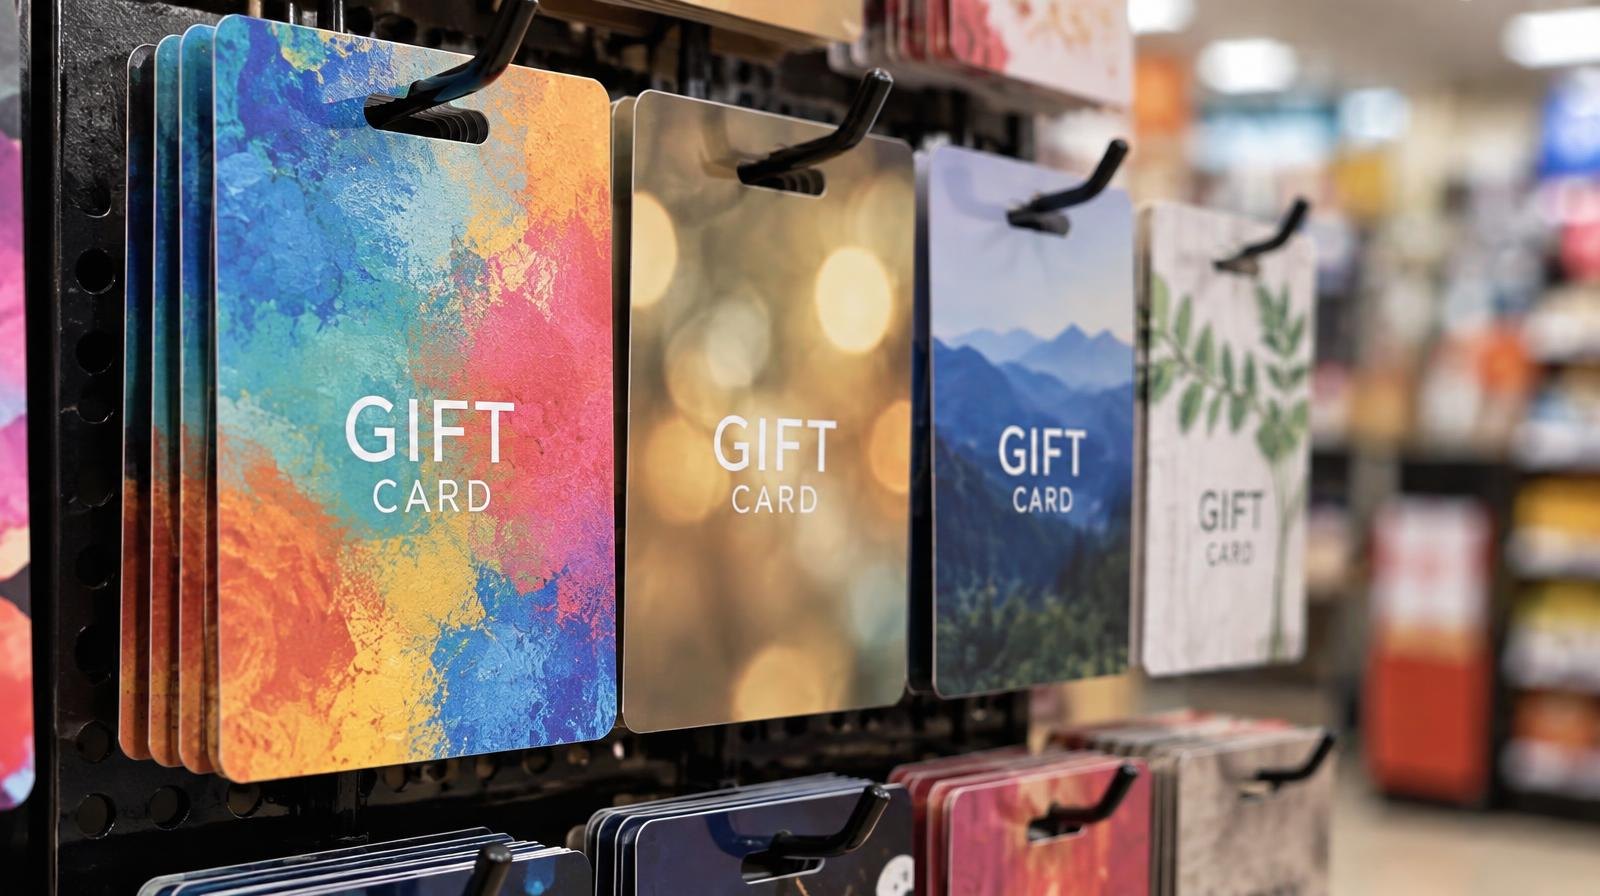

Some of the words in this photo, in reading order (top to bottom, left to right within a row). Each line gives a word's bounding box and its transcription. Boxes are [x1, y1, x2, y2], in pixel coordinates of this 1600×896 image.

[345, 395, 515, 463] GIFT
[713, 414, 838, 473] GIFT
[998, 425, 1087, 477] GIFT
[373, 478, 491, 513] CARD
[732, 484, 818, 514] CARD
[1013, 486, 1074, 513] CARD
[1199, 489, 1264, 532] GIFT
[1205, 541, 1255, 567] CARD
